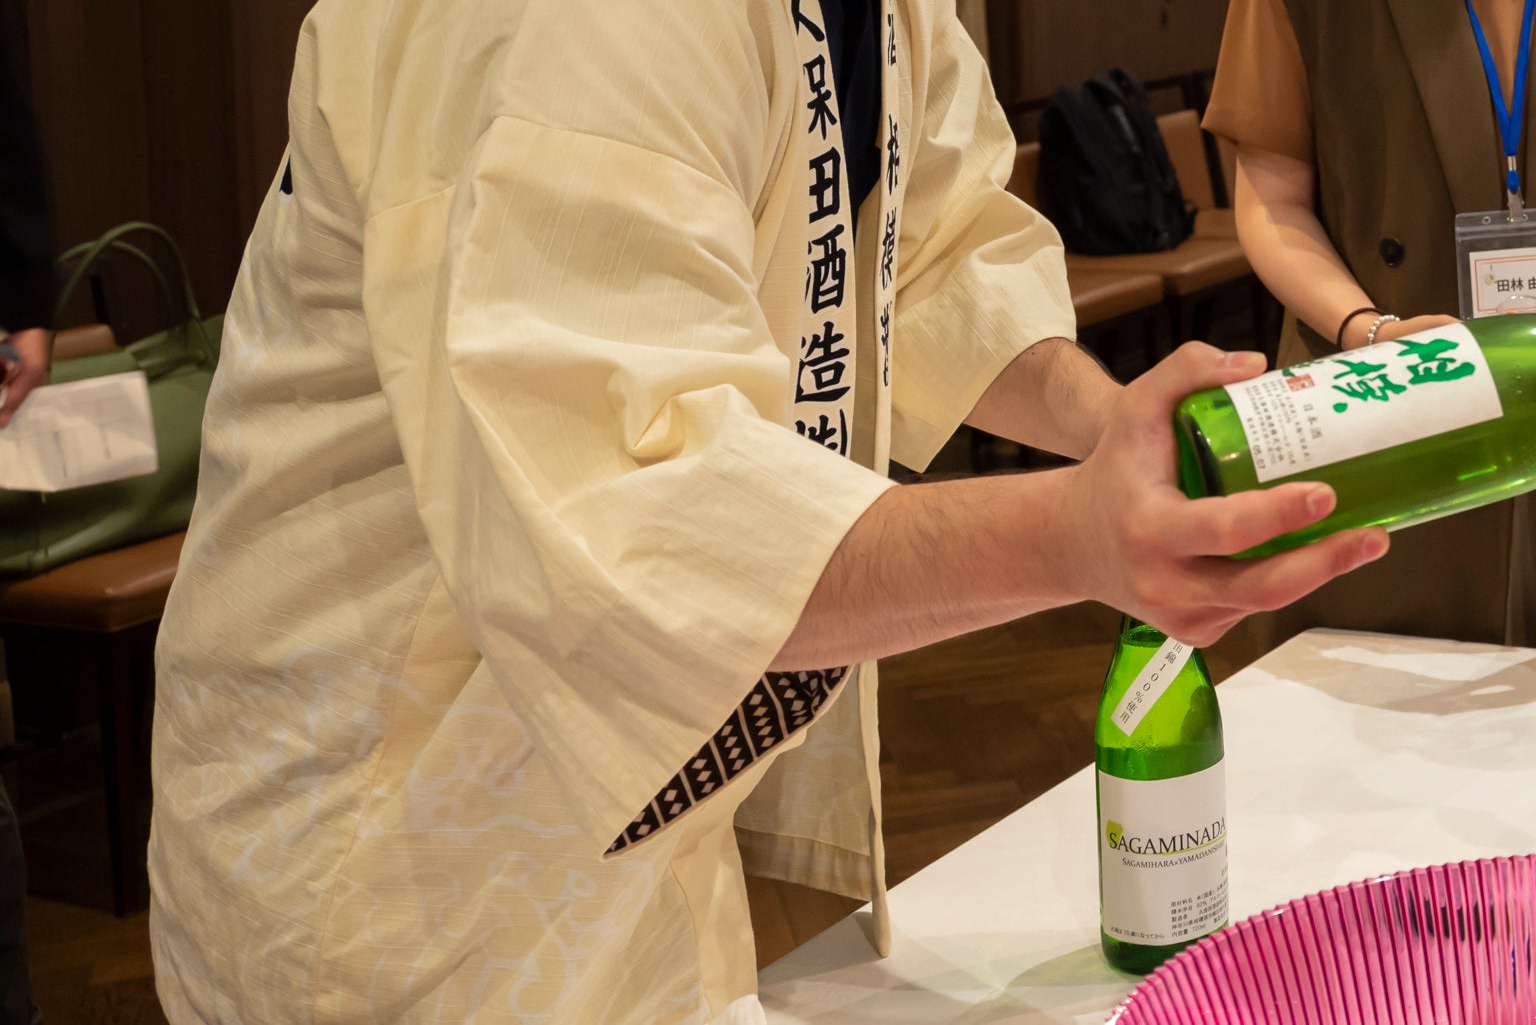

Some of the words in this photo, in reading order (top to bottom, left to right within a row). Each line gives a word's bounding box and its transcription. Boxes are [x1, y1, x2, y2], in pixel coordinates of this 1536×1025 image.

[1496, 278, 1524, 292] 田林
[1282, 339, 1476, 413] 相模
[1109, 816, 1226, 855] SAGAMINADA
